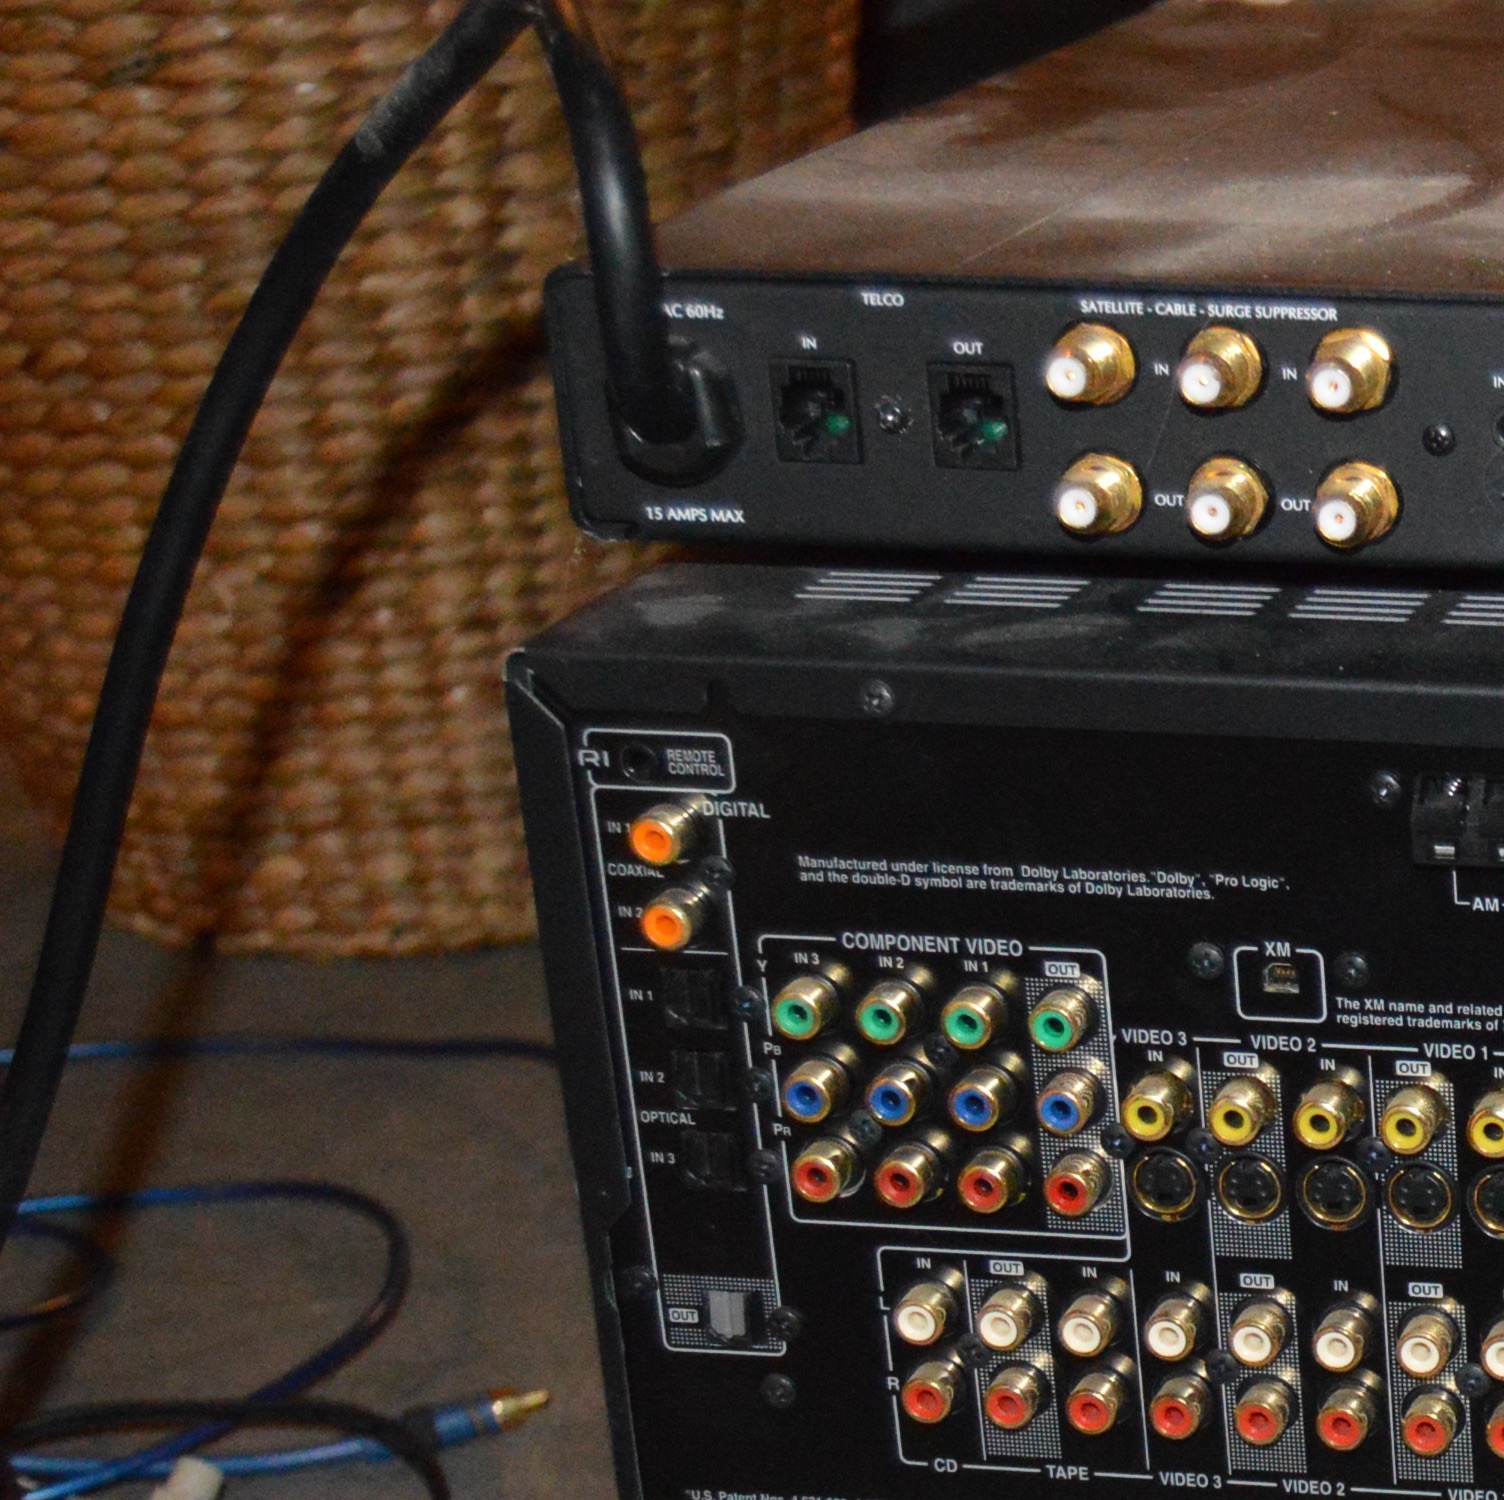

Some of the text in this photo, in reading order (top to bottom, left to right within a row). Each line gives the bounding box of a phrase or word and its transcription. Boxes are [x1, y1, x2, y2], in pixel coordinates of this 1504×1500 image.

[860, 290, 904, 307] TELCO
[1079, 298, 1337, 321] SATELLITE CABLE SURGE SUPPRESSOR
[800, 335, 817, 349] IN
[951, 340, 983, 355] OUT
[645, 506, 745, 523] 15 AMPS MAX
[665, 748, 715, 764] REMOTE
[667, 761, 725, 776] CONTROL
[702, 800, 771, 819] DIGITAL
[1473, 898, 1500, 912] AM
[841, 931, 1023, 957] COMPONENT VIDEO
[1264, 940, 1291, 957] XM
[1335, 996, 1360, 1010] The
[1363, 997, 1384, 1011] XM
[1388, 1001, 1425, 1013] name
[1427, 1002, 1453, 1014] and
[1456, 1002, 1503, 1017] related
[1336, 1012, 1403, 1027] registered
[1406, 1015, 1482, 1030] trademarks
[1485, 1018, 1498, 1031] of
[933, 1457, 958, 1473] CD
[1046, 1464, 1090, 1482] TAPE
